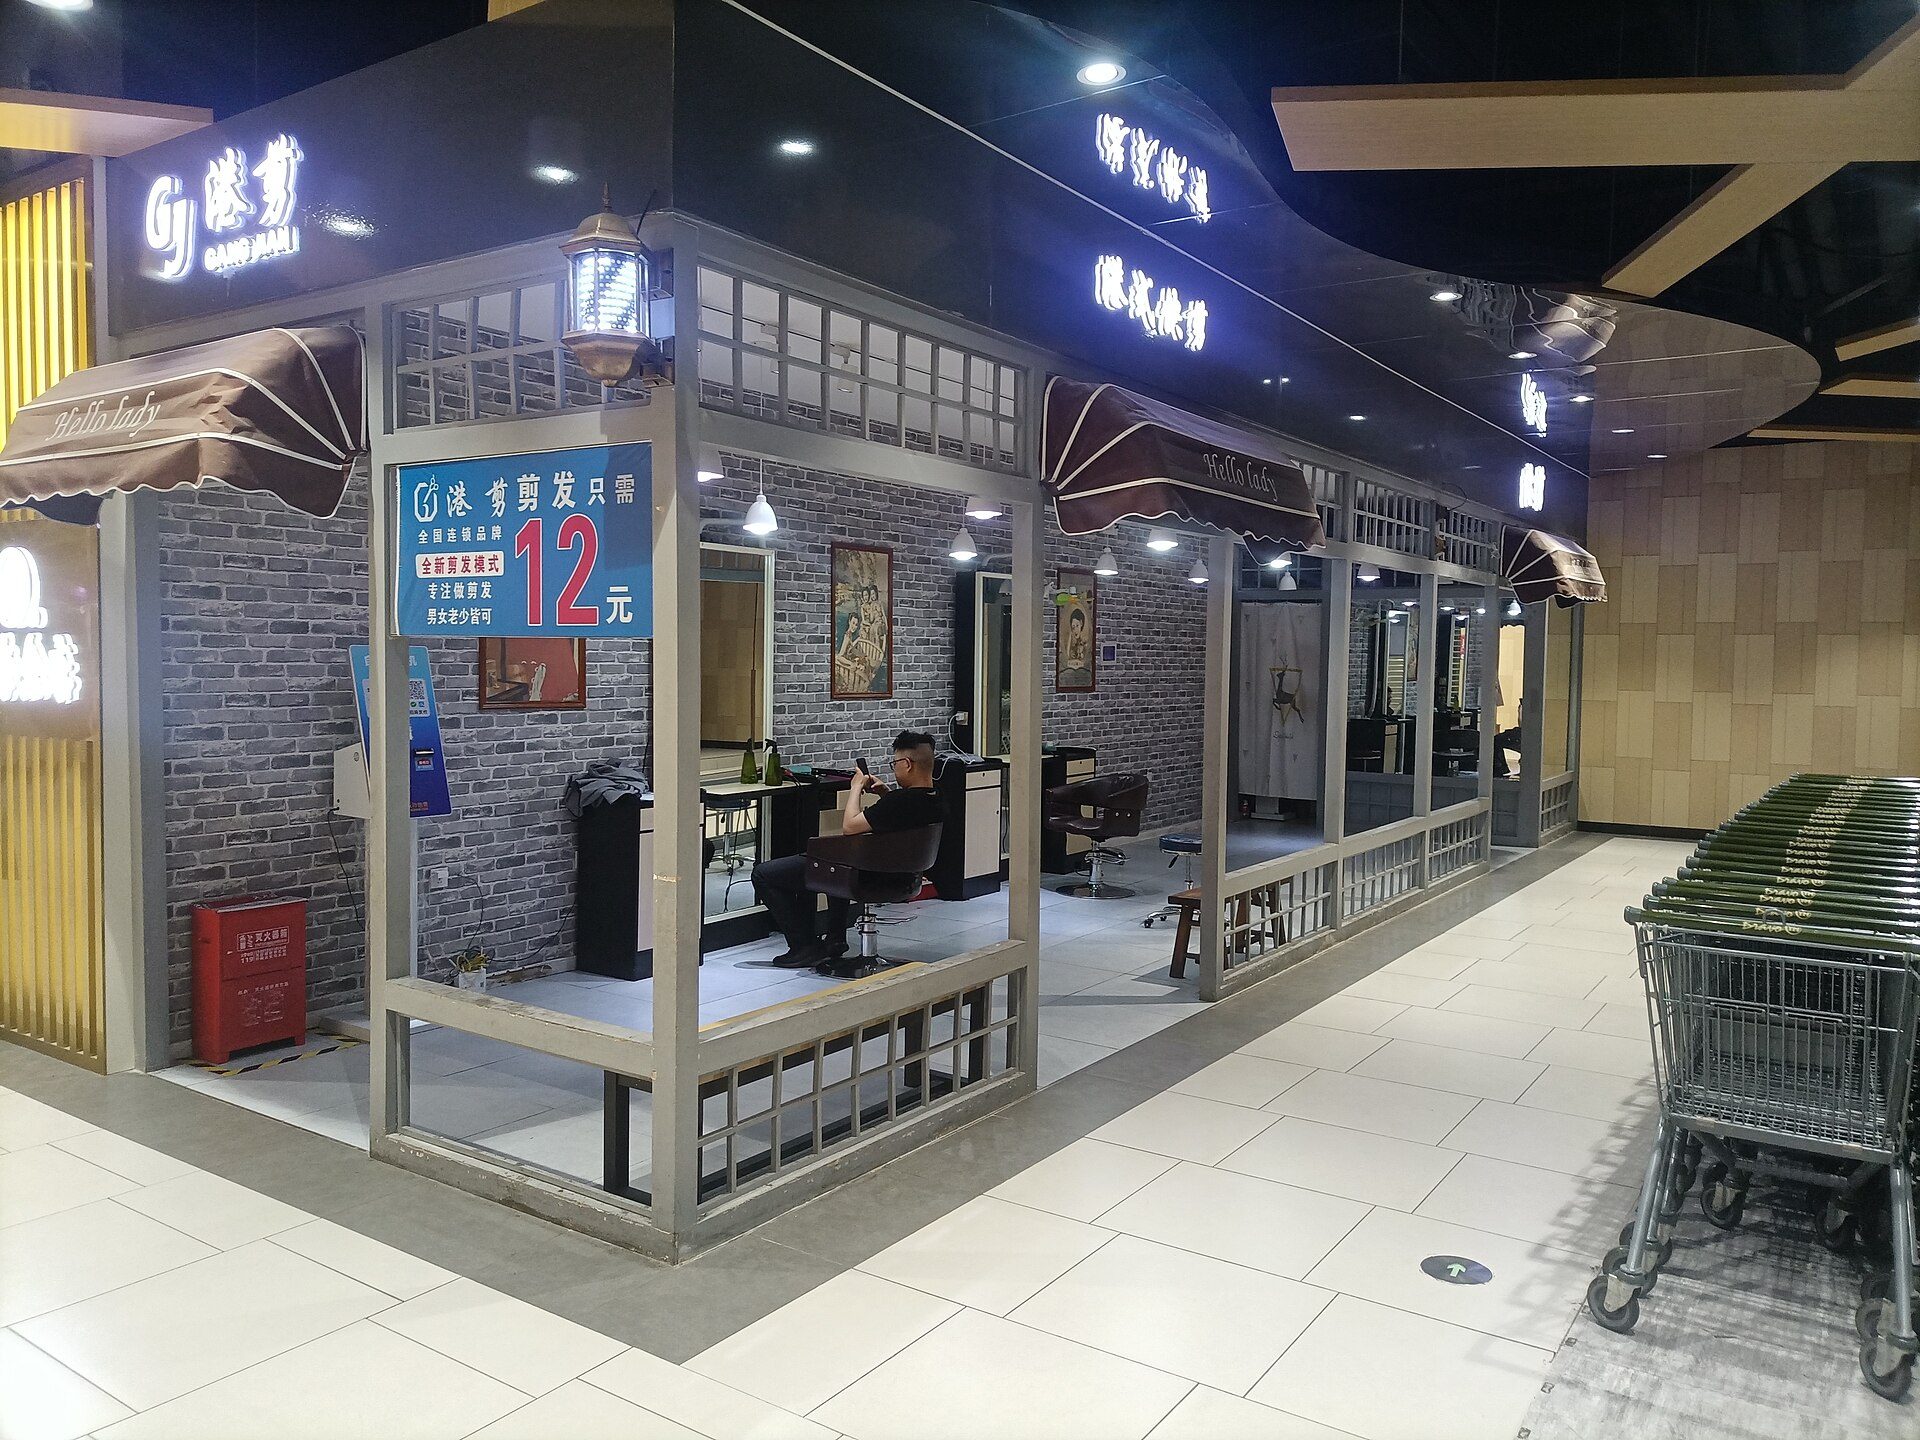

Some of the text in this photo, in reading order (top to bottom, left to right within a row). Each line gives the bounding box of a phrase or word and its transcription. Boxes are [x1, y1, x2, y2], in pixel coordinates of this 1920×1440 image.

[45, 391, 161, 441] Hello lady
[1203, 453, 1278, 502] Hello lady
[417, 525, 503, 545] 全国连锁品牌
[421, 554, 500, 576] 全新剪发模式
[427, 581, 493, 601] 专注做剪发
[426, 607, 493, 626] 男女老少皆可
